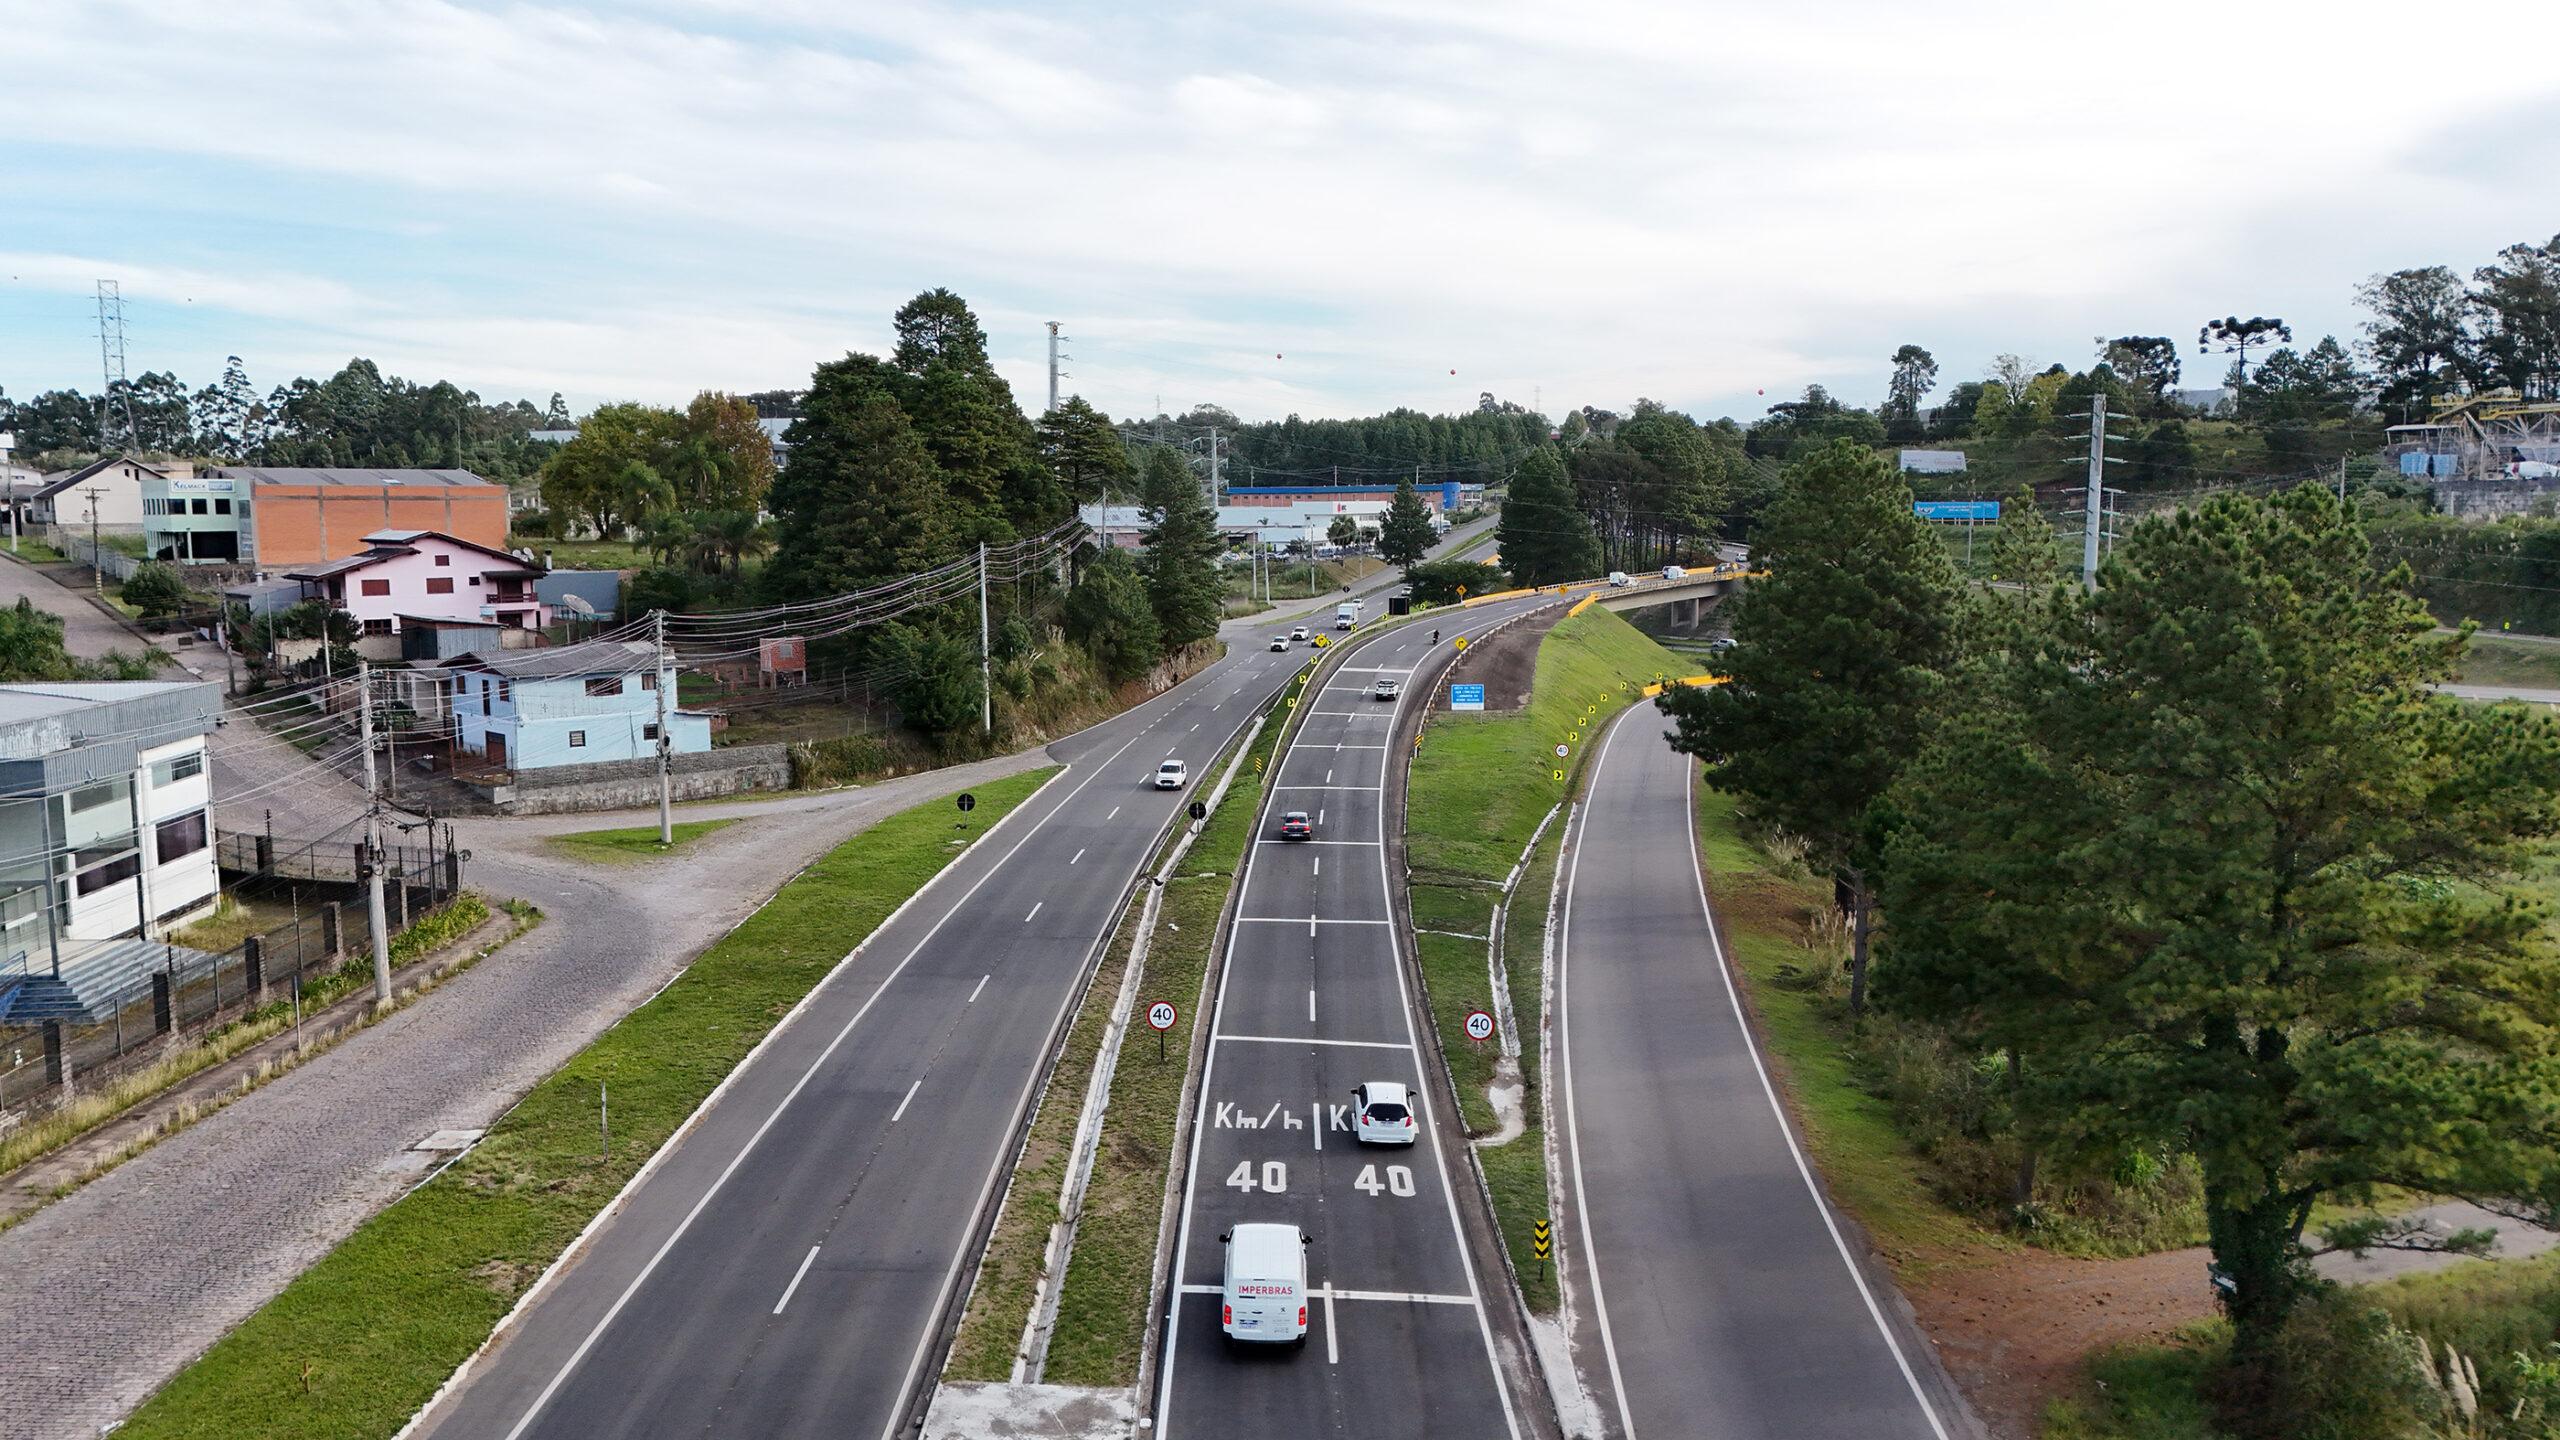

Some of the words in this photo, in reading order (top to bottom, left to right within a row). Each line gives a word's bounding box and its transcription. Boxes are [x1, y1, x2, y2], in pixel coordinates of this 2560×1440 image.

[1152, 1008, 1172, 1020] 40
[1470, 1018, 1490, 1031] 40
[1213, 1101, 1303, 1129] Km/h
[1226, 1160, 1287, 1193] 40
[1354, 1164, 1416, 1197] 40
[1238, 1286, 1293, 1296] IMPERBRAS
